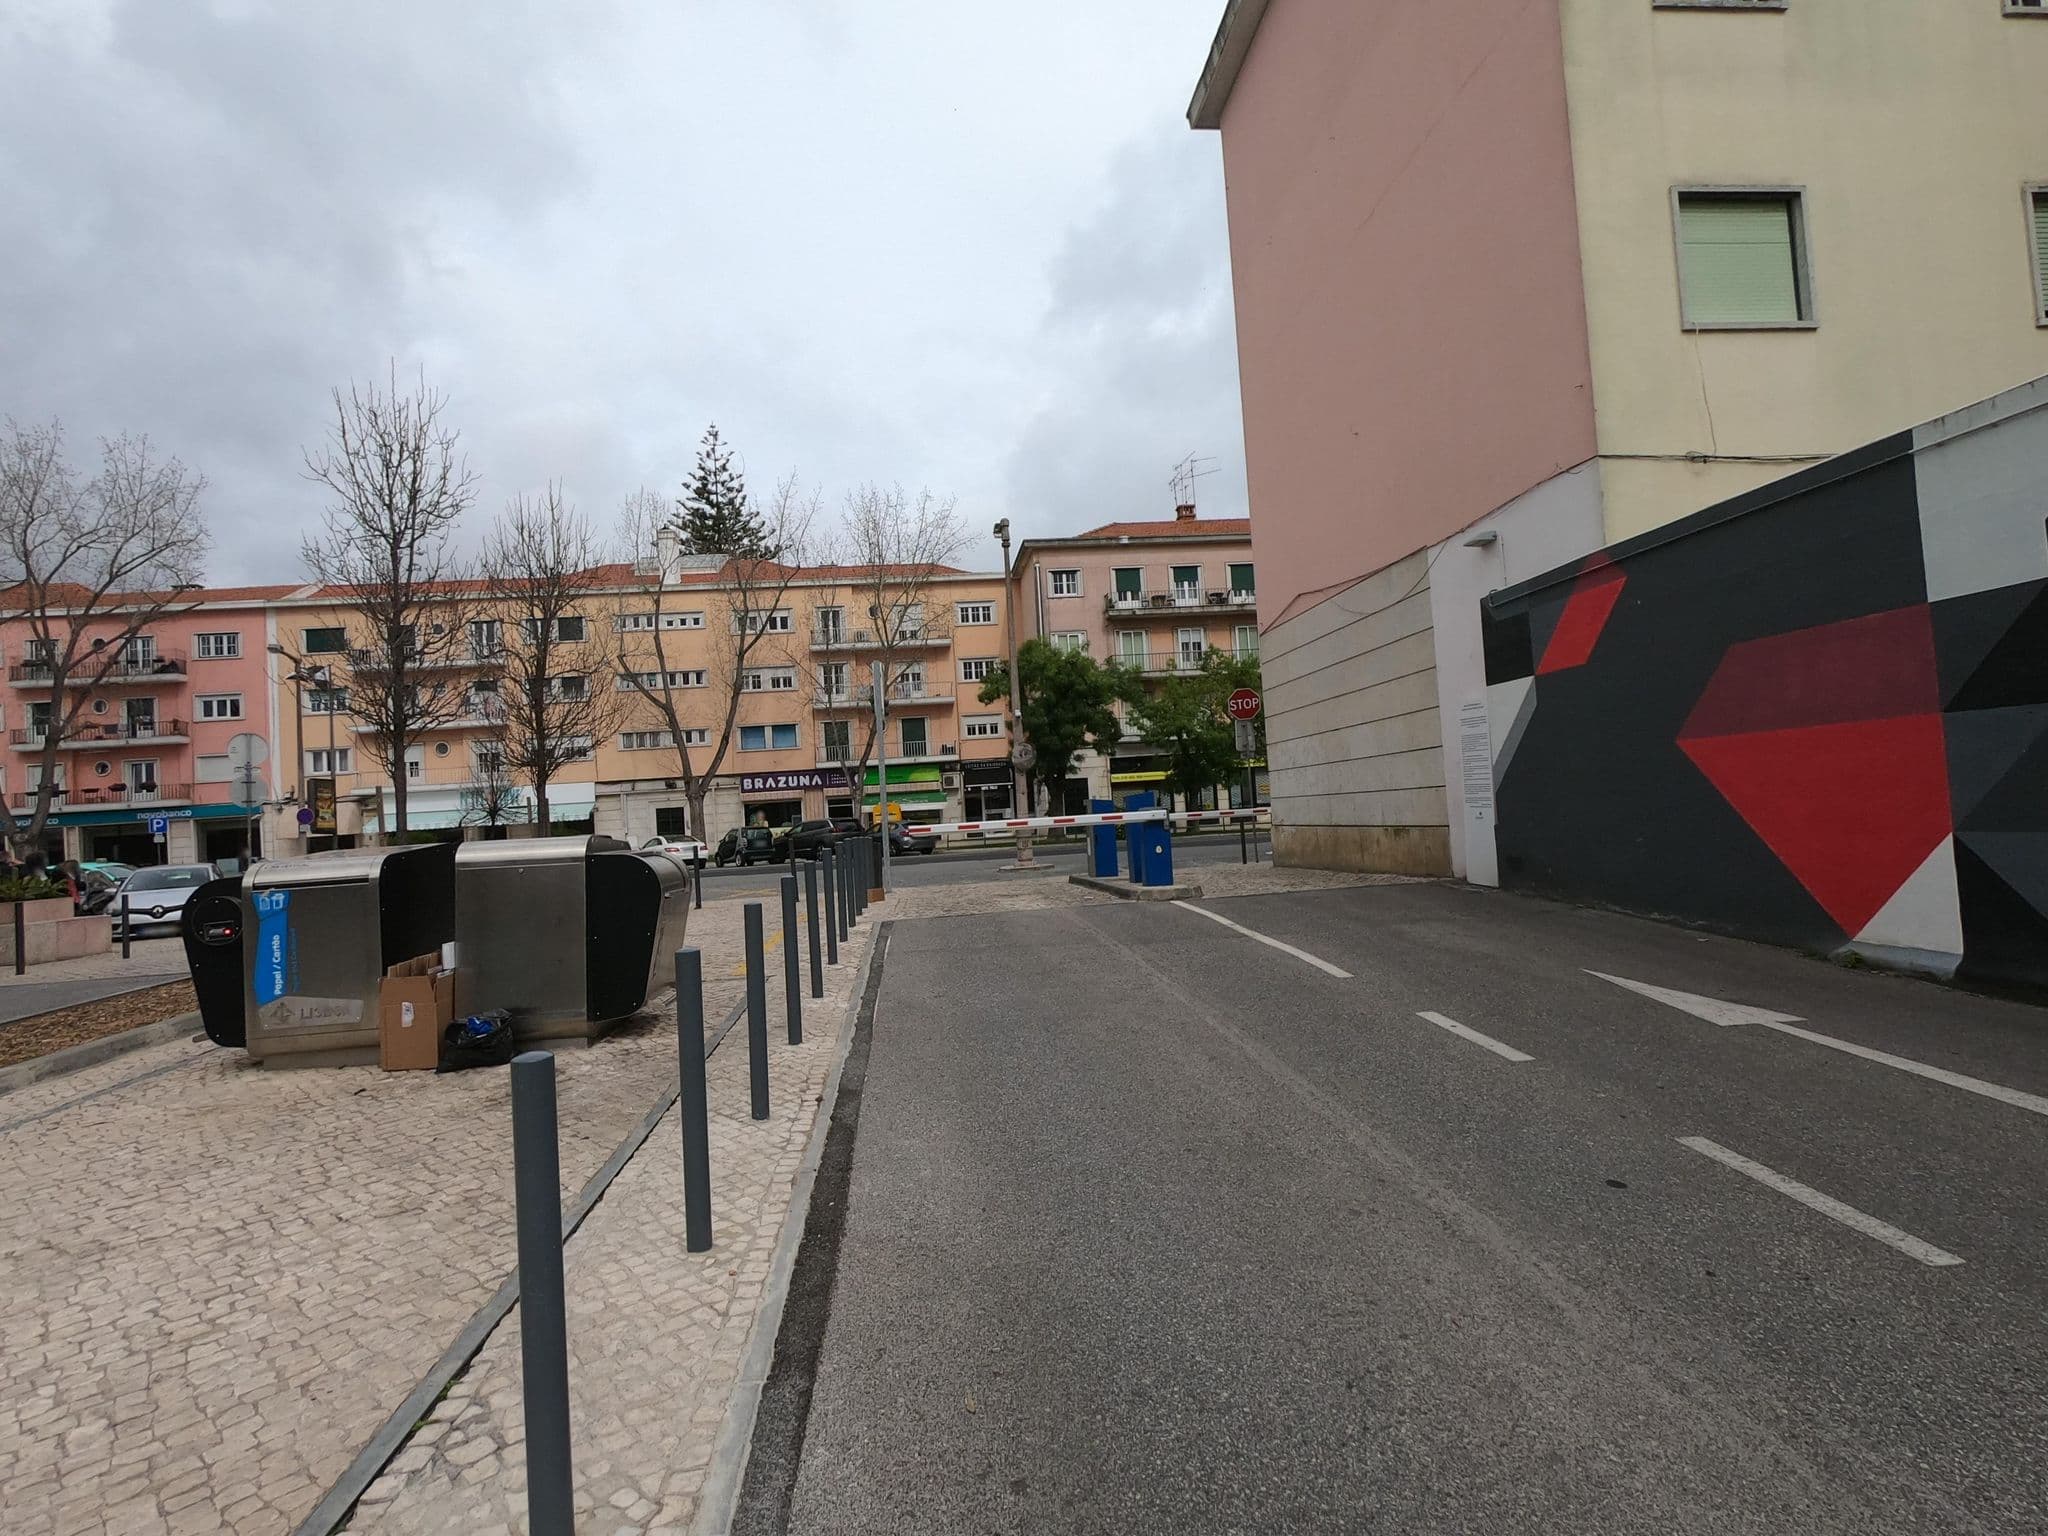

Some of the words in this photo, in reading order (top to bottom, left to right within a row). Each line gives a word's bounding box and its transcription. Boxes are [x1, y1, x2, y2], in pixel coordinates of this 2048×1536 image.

[1229, 697, 1259, 711] STOP
[743, 774, 822, 790] BRAZUNA
[153, 819, 163, 831] P
[272, 971, 284, 995] Papel
